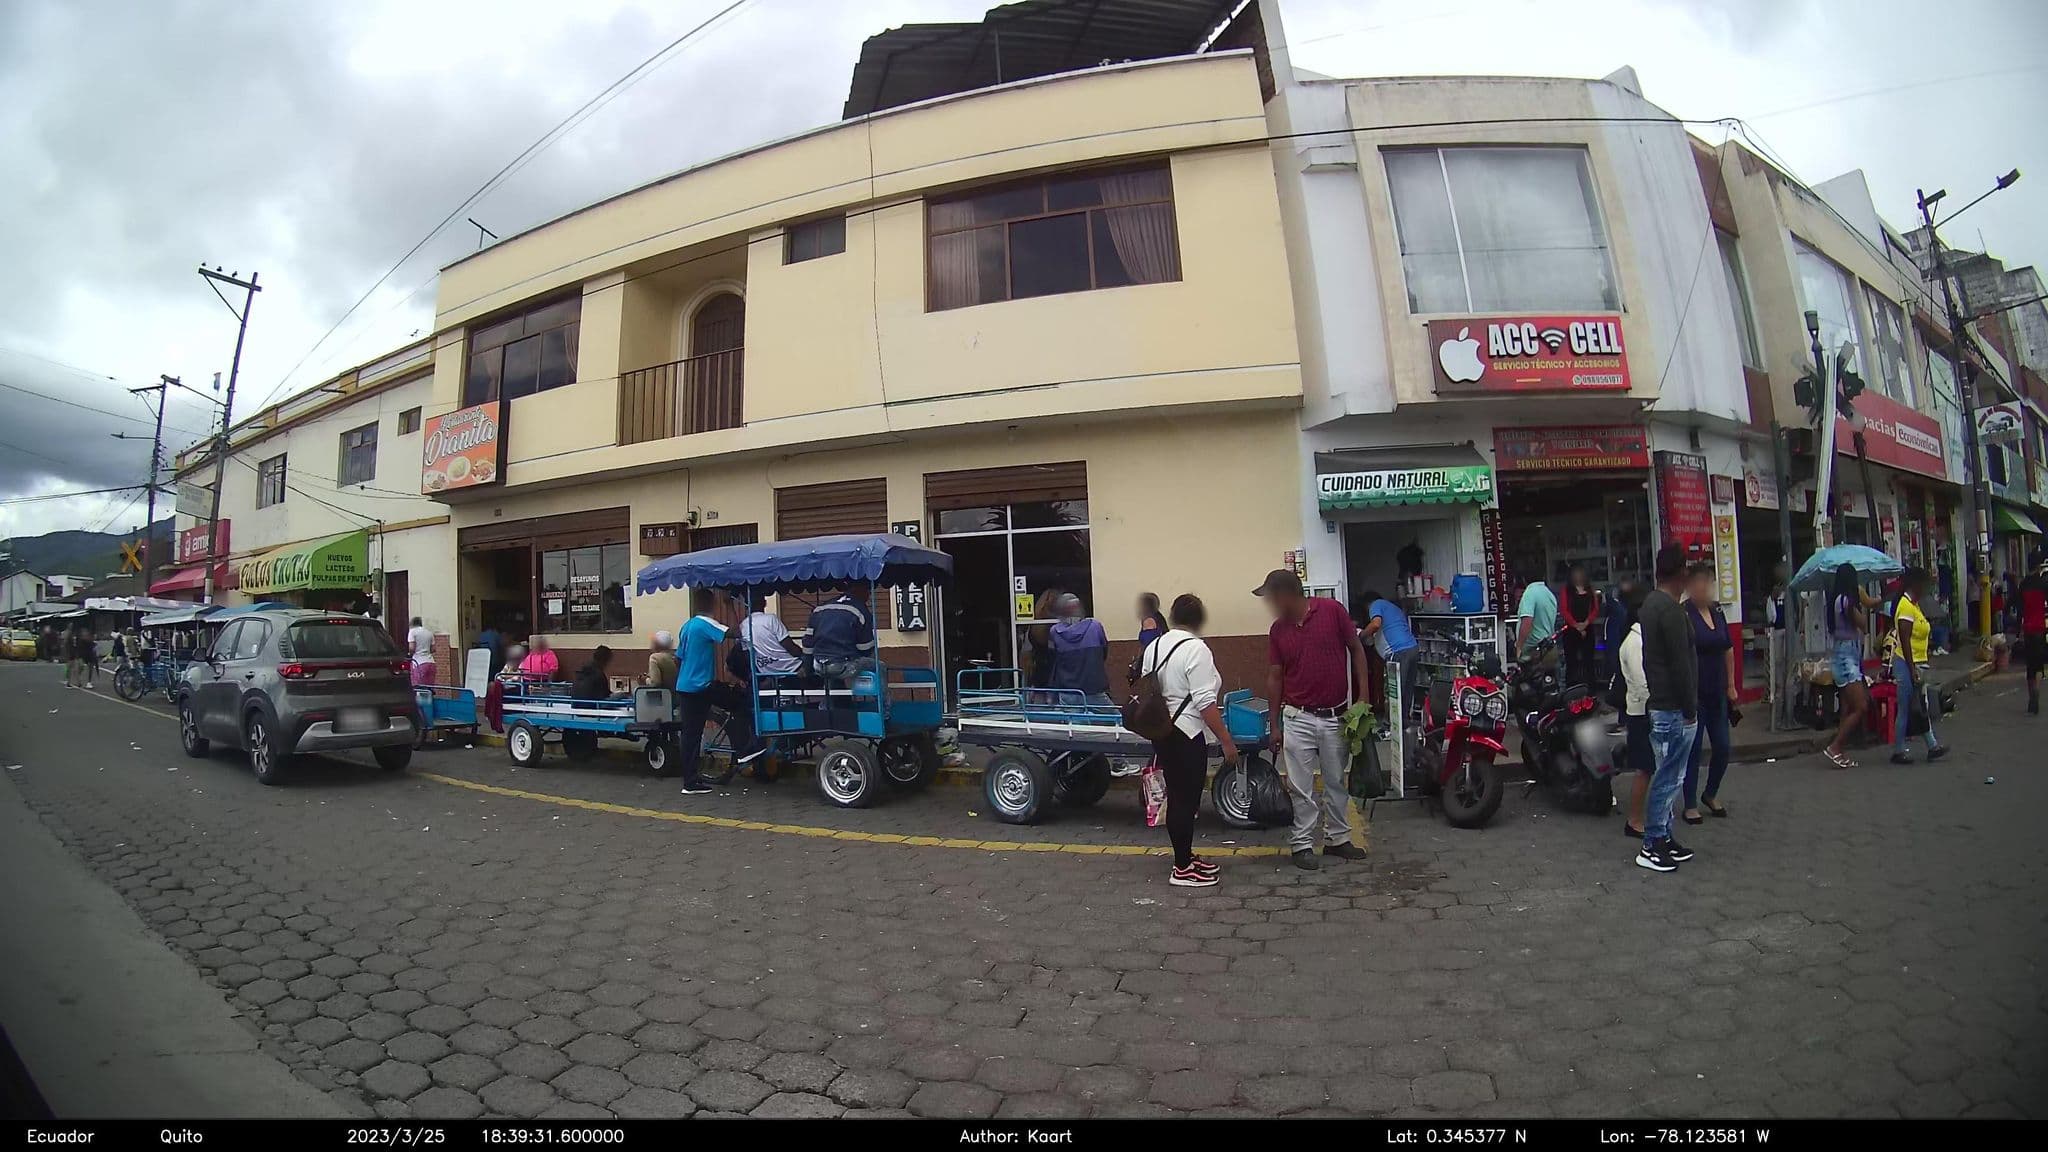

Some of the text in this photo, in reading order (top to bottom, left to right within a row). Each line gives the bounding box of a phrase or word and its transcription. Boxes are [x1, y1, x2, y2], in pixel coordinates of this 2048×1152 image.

[1488, 321, 1623, 357] ACC CELL
[1493, 358, 1620, 371] SERVICIO TÉCNICO Y ACCESORIOS
[425, 415, 497, 466] Dianita
[1516, 459, 1551, 469] SERVICIO
[1584, 456, 1631, 467] GARANTIZADO
[1321, 474, 1382, 492] CUIDADO
[1387, 471, 1449, 489] NATURAL
[327, 554, 353, 562] HUEVOS
[1482, 513, 1498, 613] RECARGAS
[1496, 511, 1509, 612] ACCESORIOS
[241, 553, 311, 589] POLLOS FRUTAS
[325, 564, 355, 573] LACTEOS
[312, 574, 337, 582] PULPAS
[570, 575, 600, 583] DESAYUNOS
